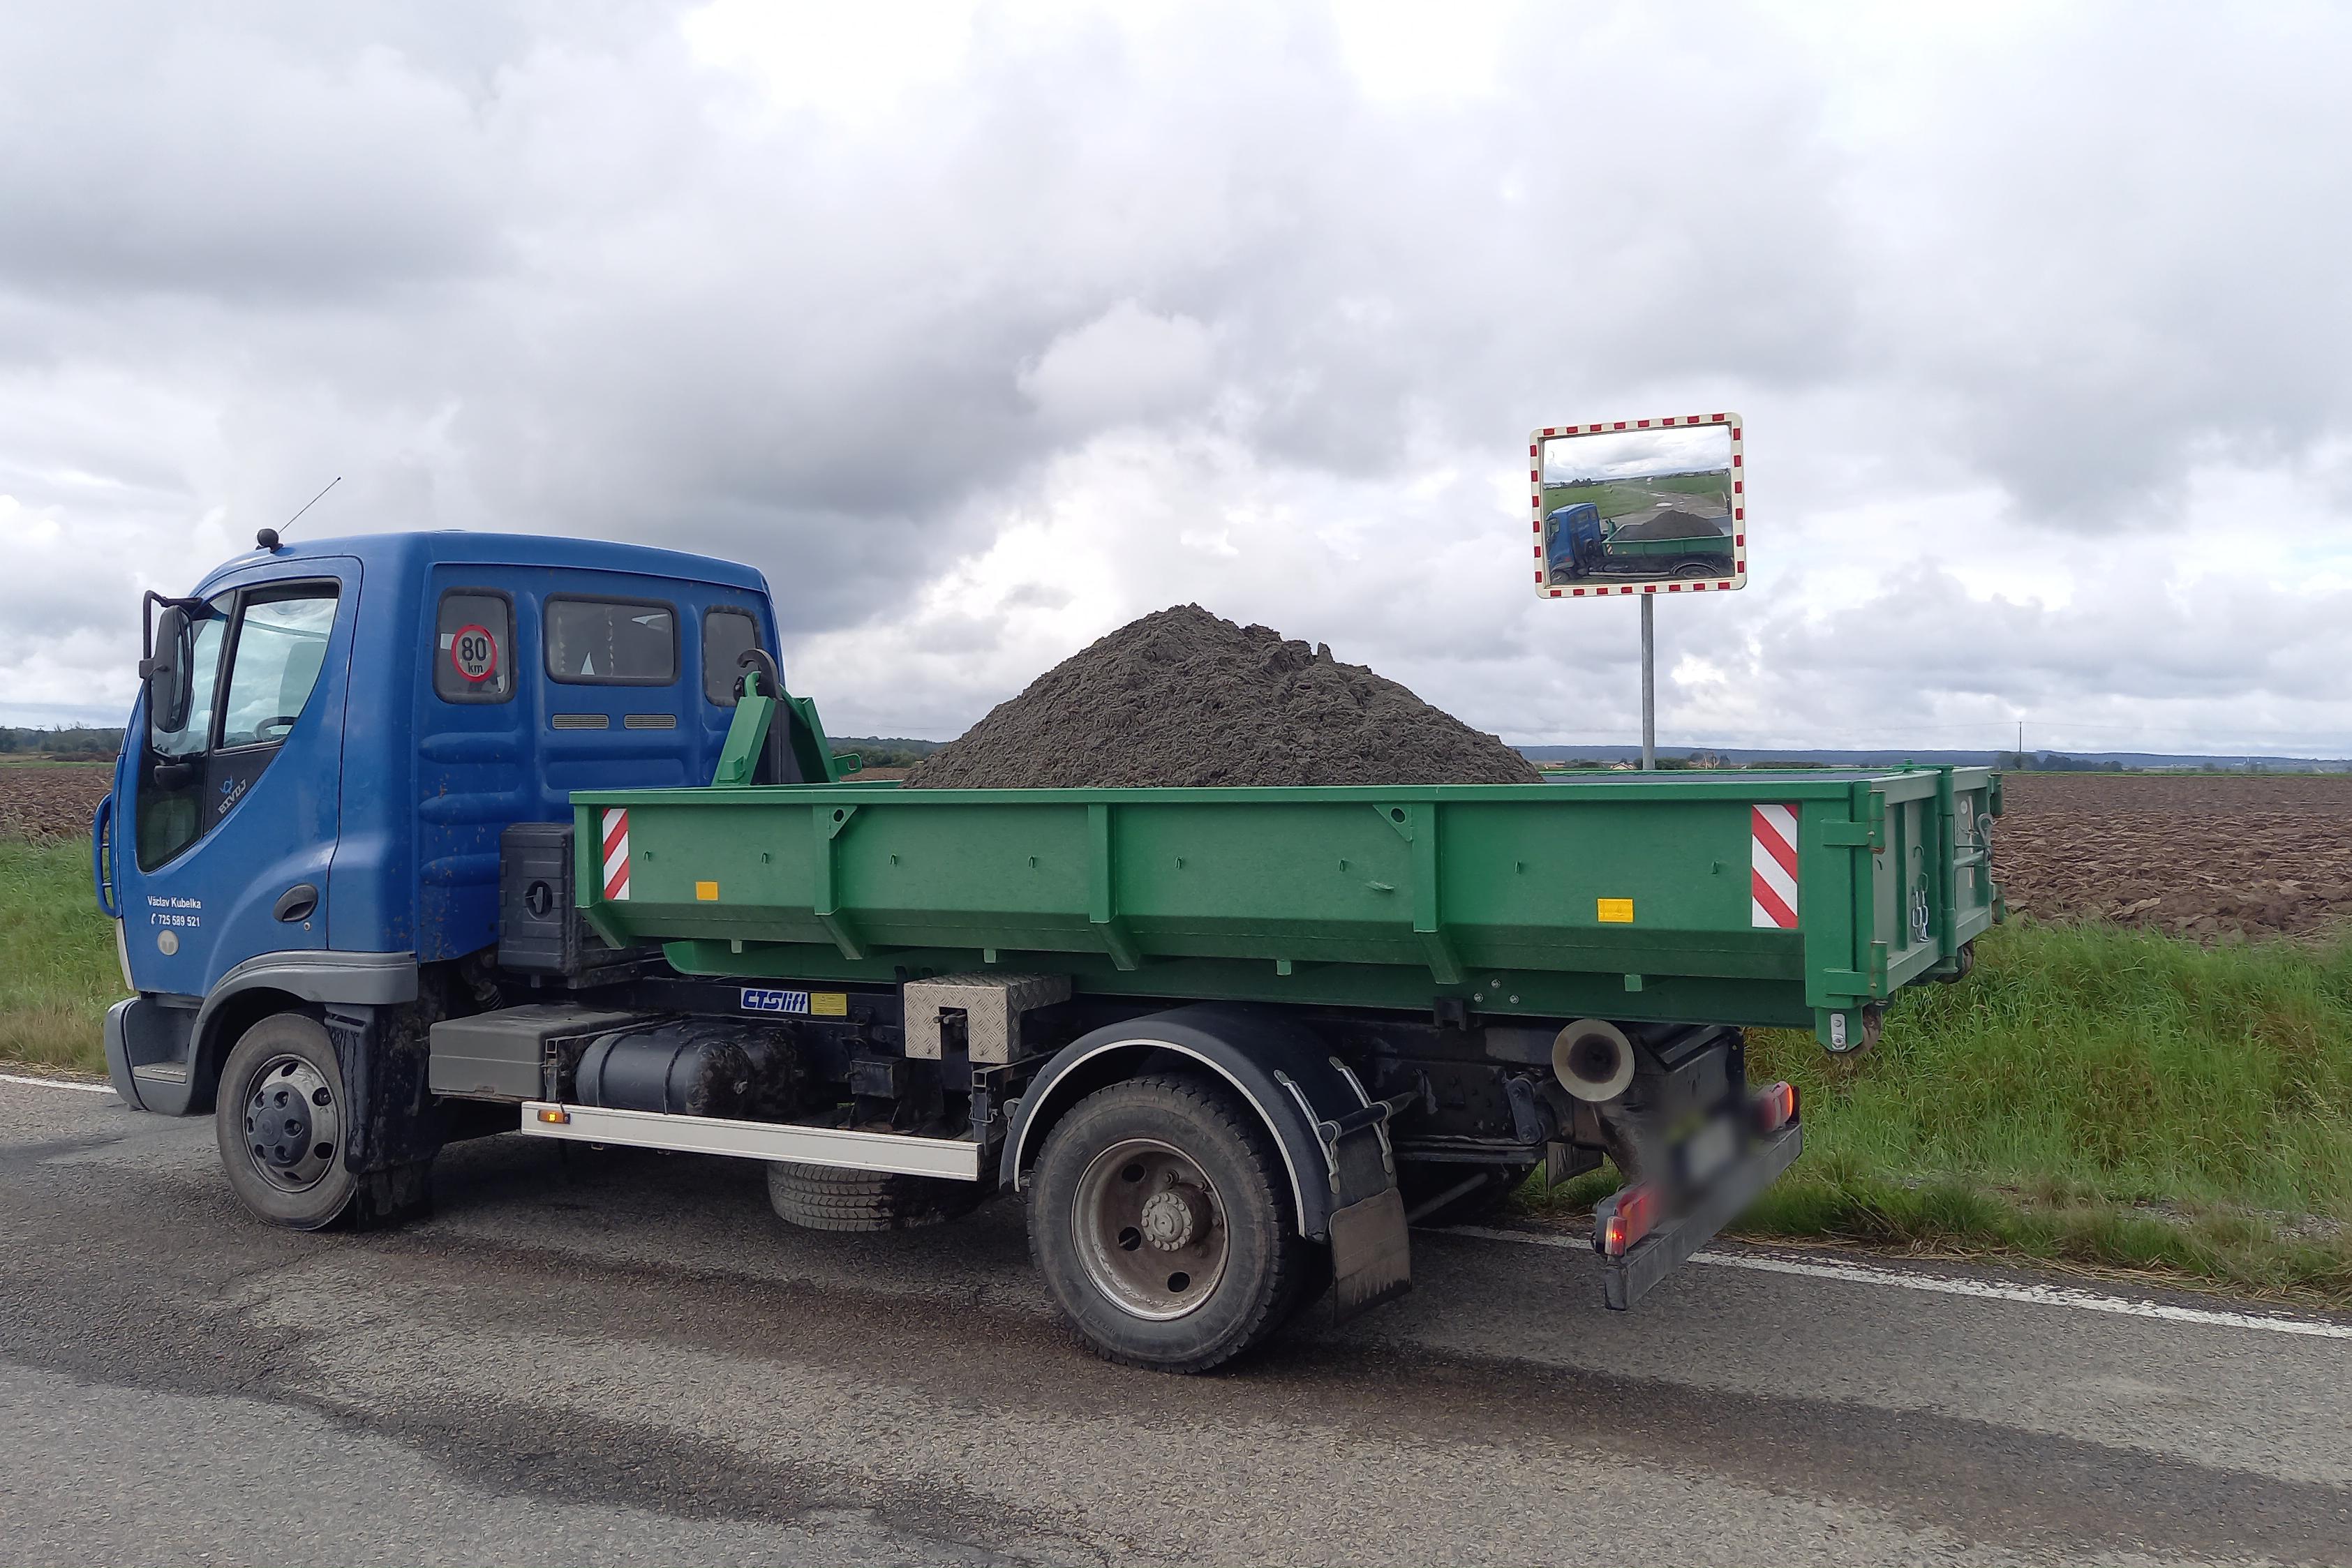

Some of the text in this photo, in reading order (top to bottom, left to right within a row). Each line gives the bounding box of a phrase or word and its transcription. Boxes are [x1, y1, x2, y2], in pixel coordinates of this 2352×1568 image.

[461, 636, 487, 662] 80
[468, 662, 483, 673] km
[171, 897, 201, 909] Kubelka
[158, 914, 170, 925] 725
[187, 916, 200, 927] 521
